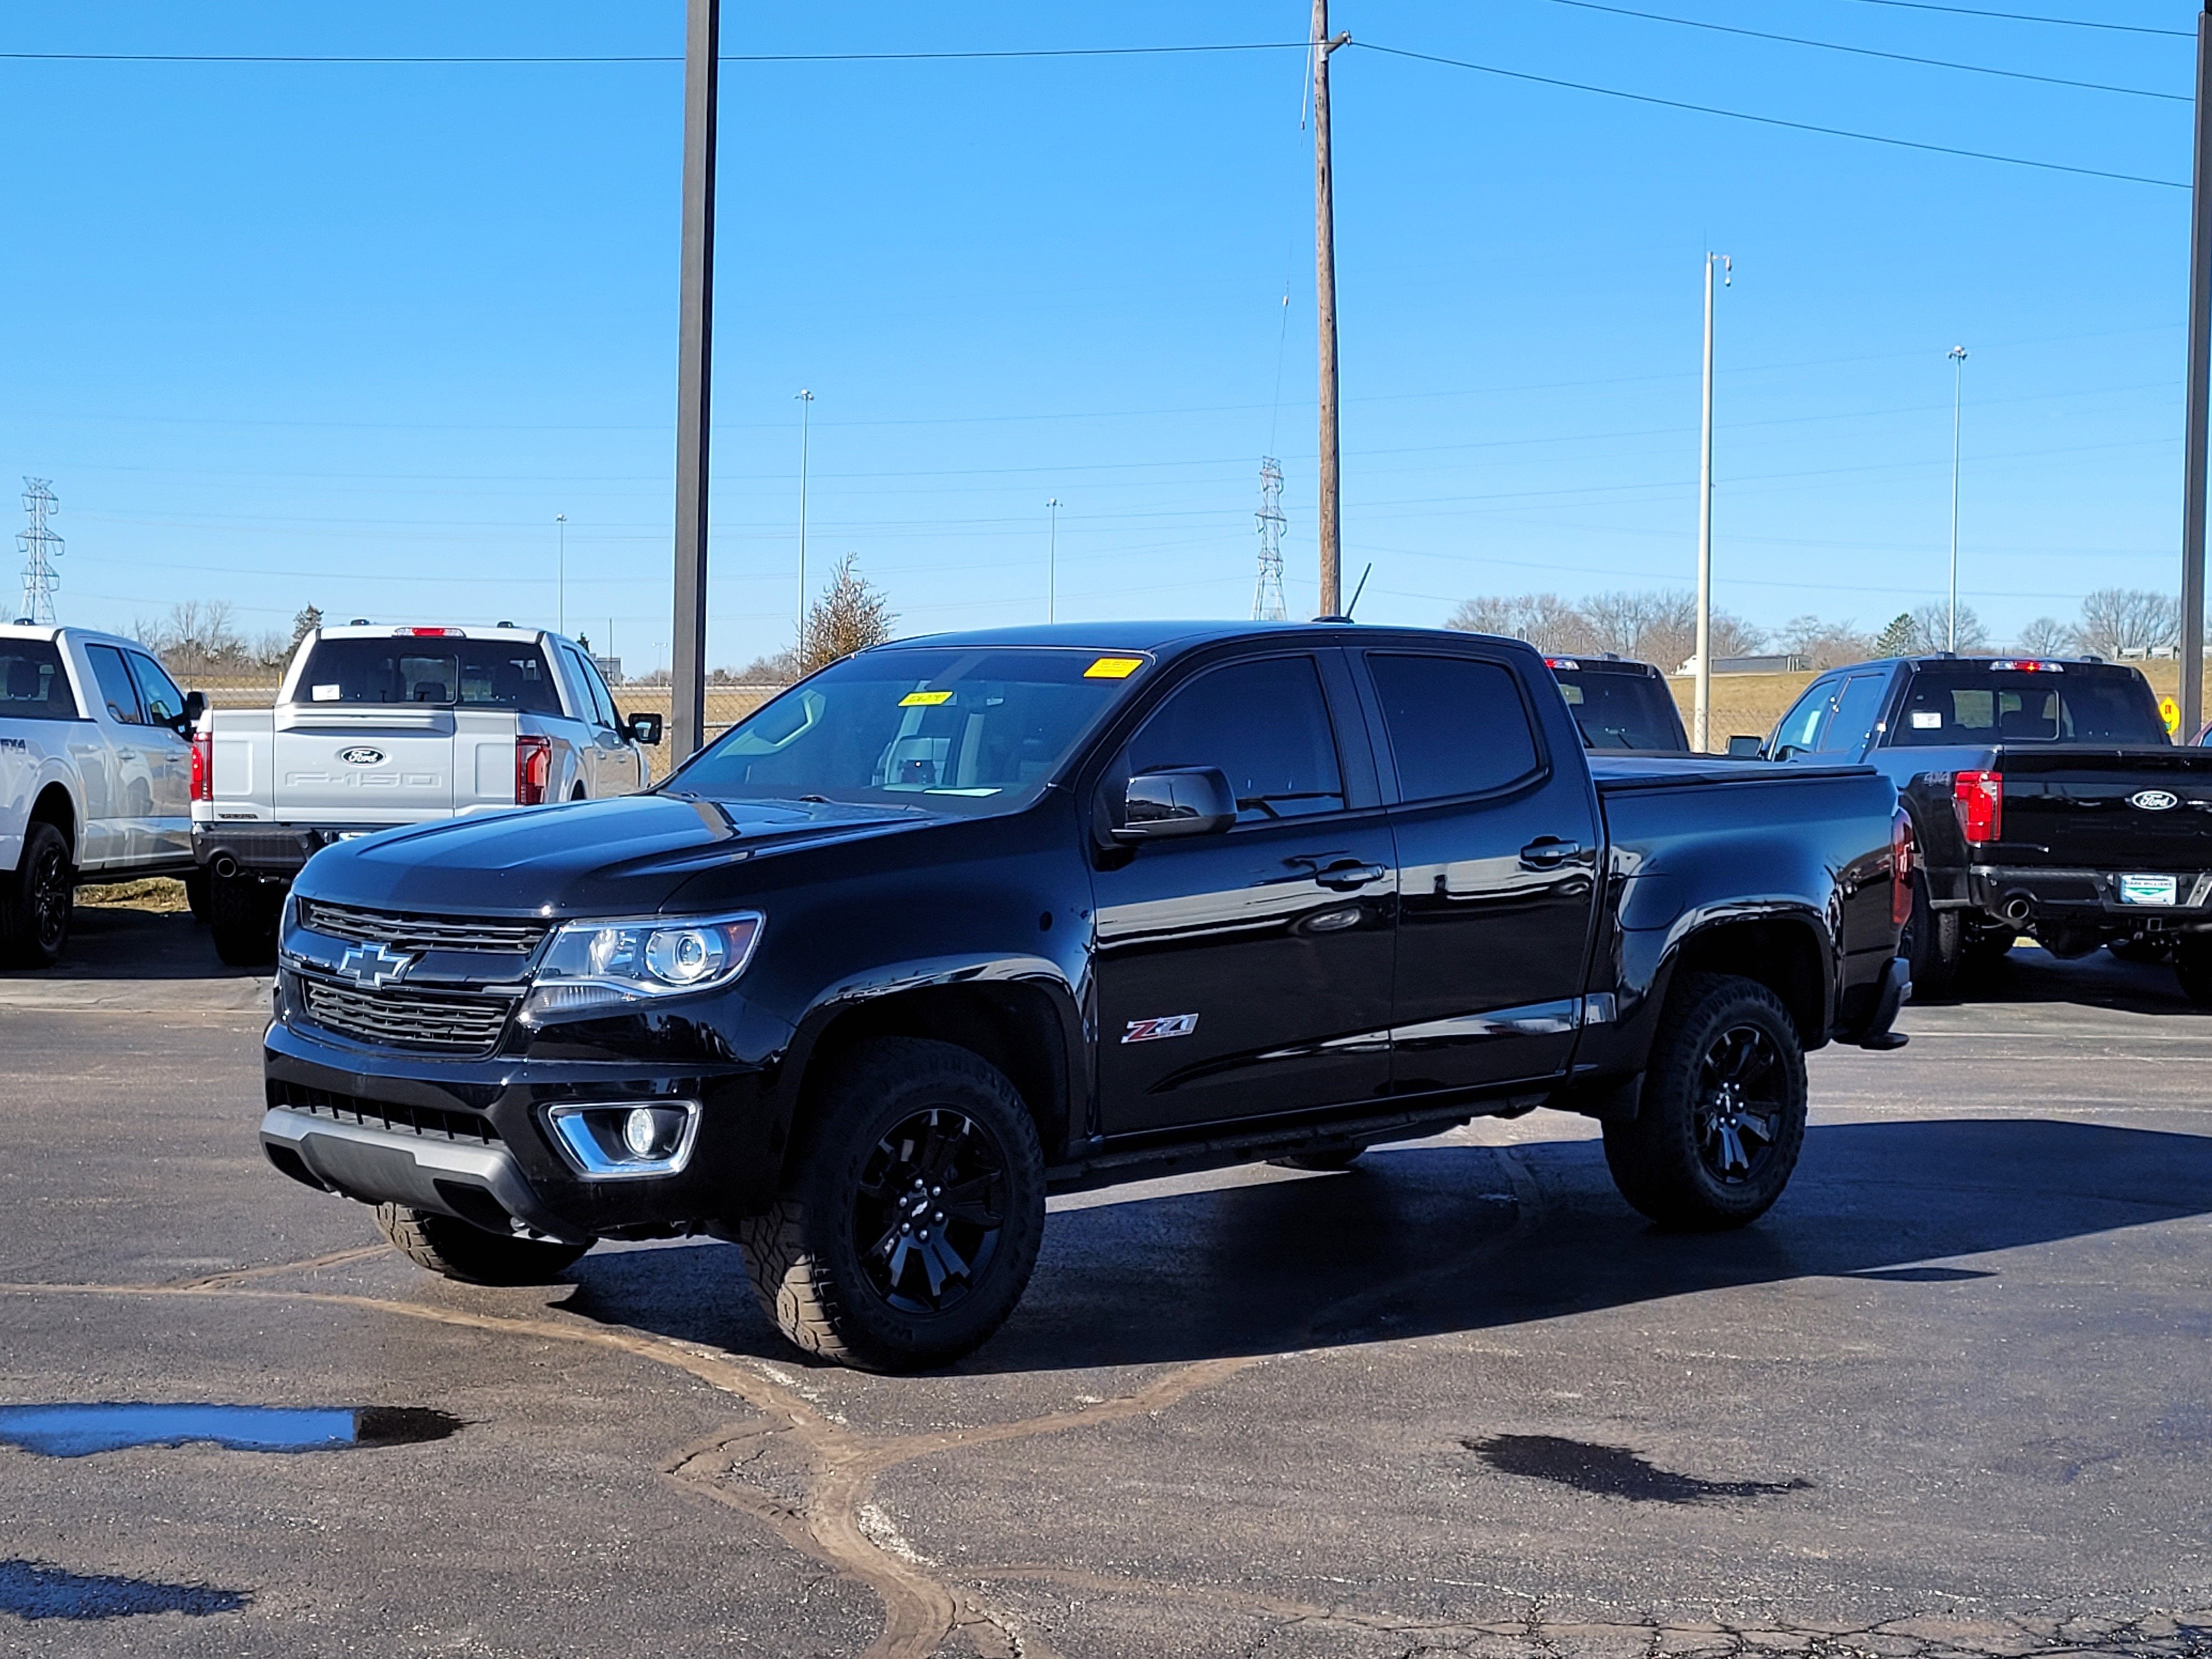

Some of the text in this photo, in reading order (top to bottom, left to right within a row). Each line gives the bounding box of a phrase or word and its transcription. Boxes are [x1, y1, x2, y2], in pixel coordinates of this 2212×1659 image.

[347, 749, 379, 763] Ford
[284, 771, 442, 788] F-150
[2138, 793, 2171, 808] Ford
[1121, 1013, 1199, 1043] Z71
